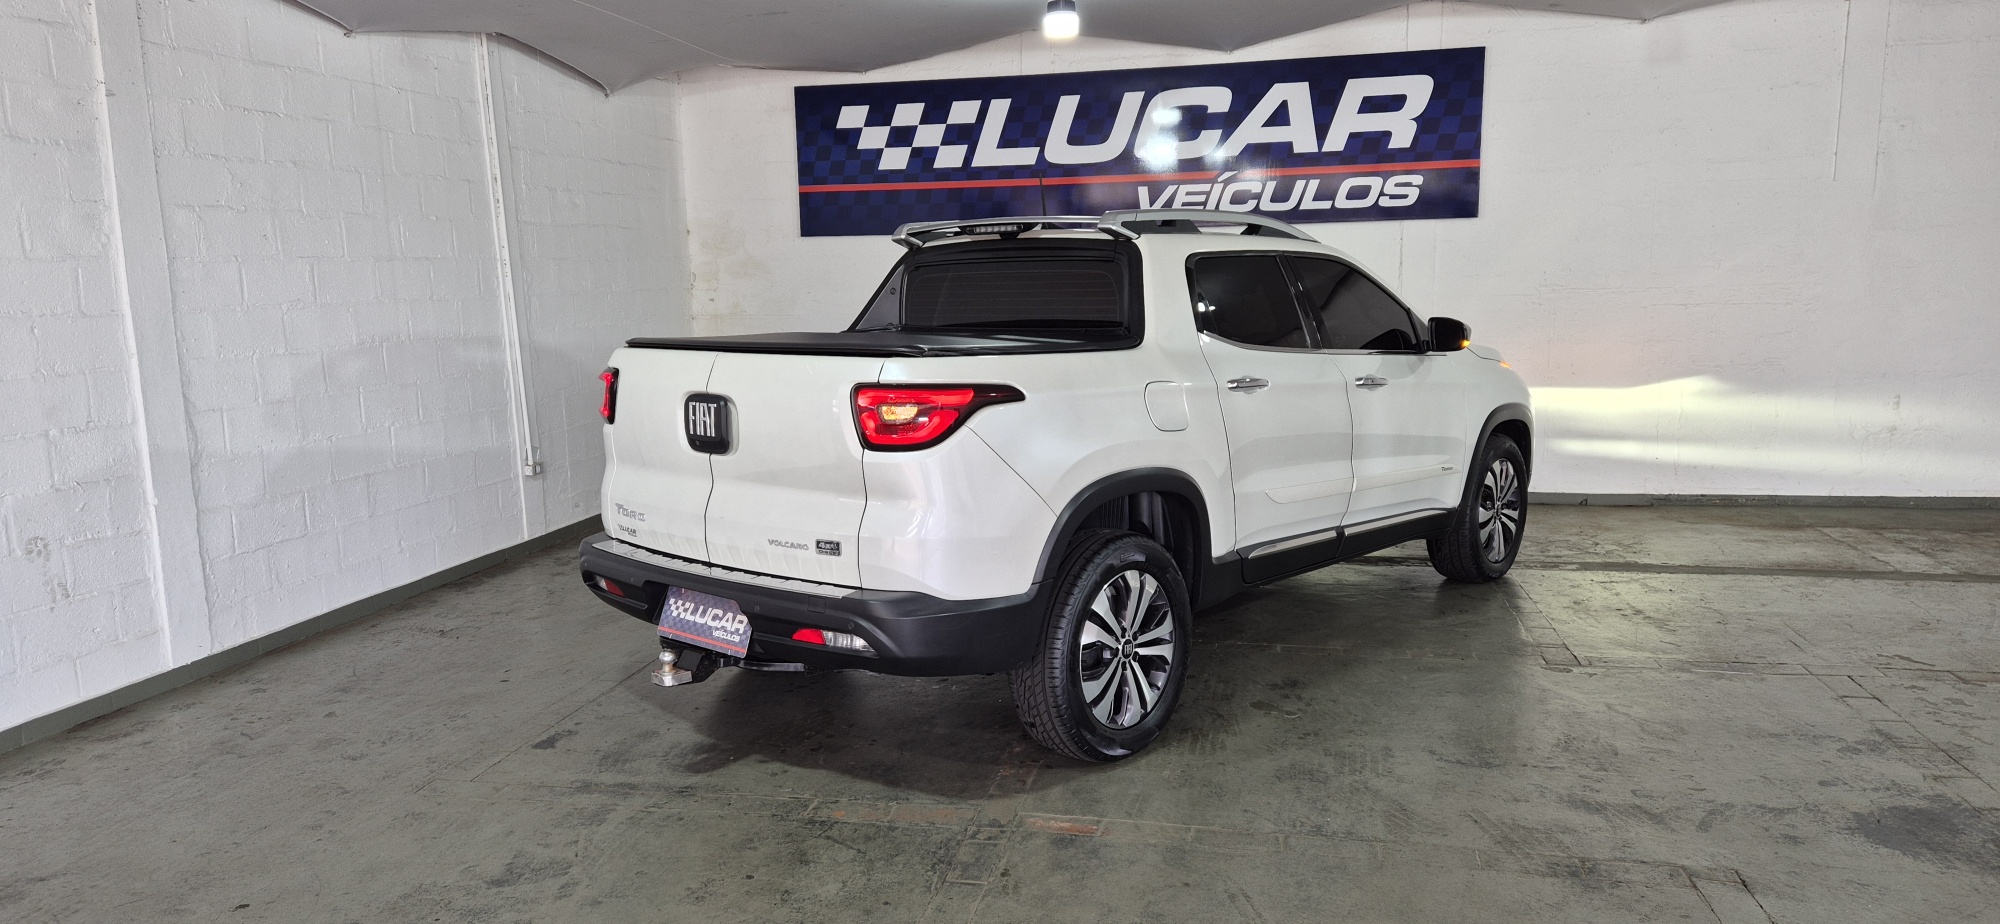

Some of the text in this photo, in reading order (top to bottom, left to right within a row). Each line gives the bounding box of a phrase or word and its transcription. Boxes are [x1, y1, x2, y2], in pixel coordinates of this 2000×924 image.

[972, 74, 1434, 168] LUCAR
[1137, 171, 1424, 213] VEÍCULOS
[688, 401, 717, 437] FIAT
[767, 538, 809, 551] VOLCANO
[685, 603, 748, 634] LUCAR
